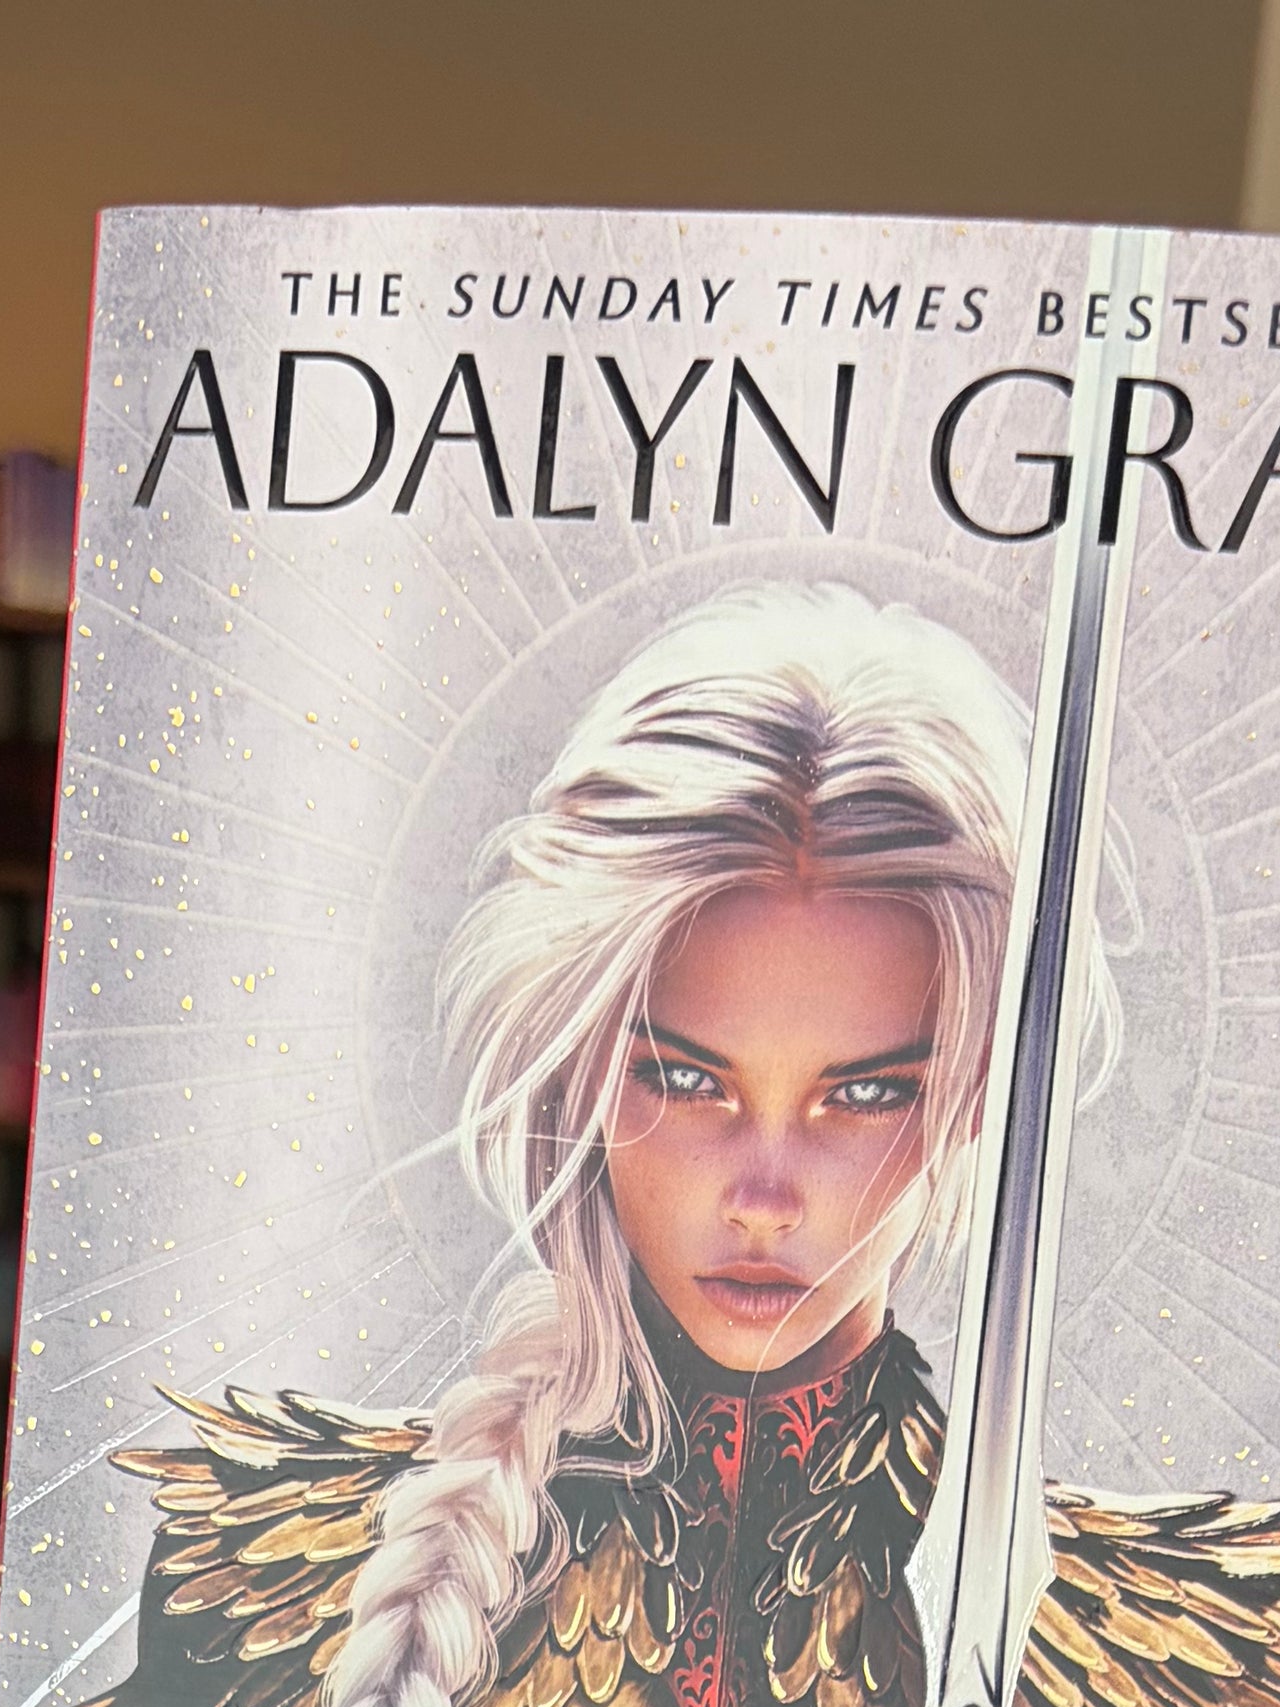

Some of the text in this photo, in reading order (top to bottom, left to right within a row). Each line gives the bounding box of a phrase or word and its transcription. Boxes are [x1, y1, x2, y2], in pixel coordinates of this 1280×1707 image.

[281, 270, 404, 318] THE
[448, 274, 739, 326] SUNDAY
[776, 279, 988, 335] TIMES
[134, 345, 856, 536] ADALYN
